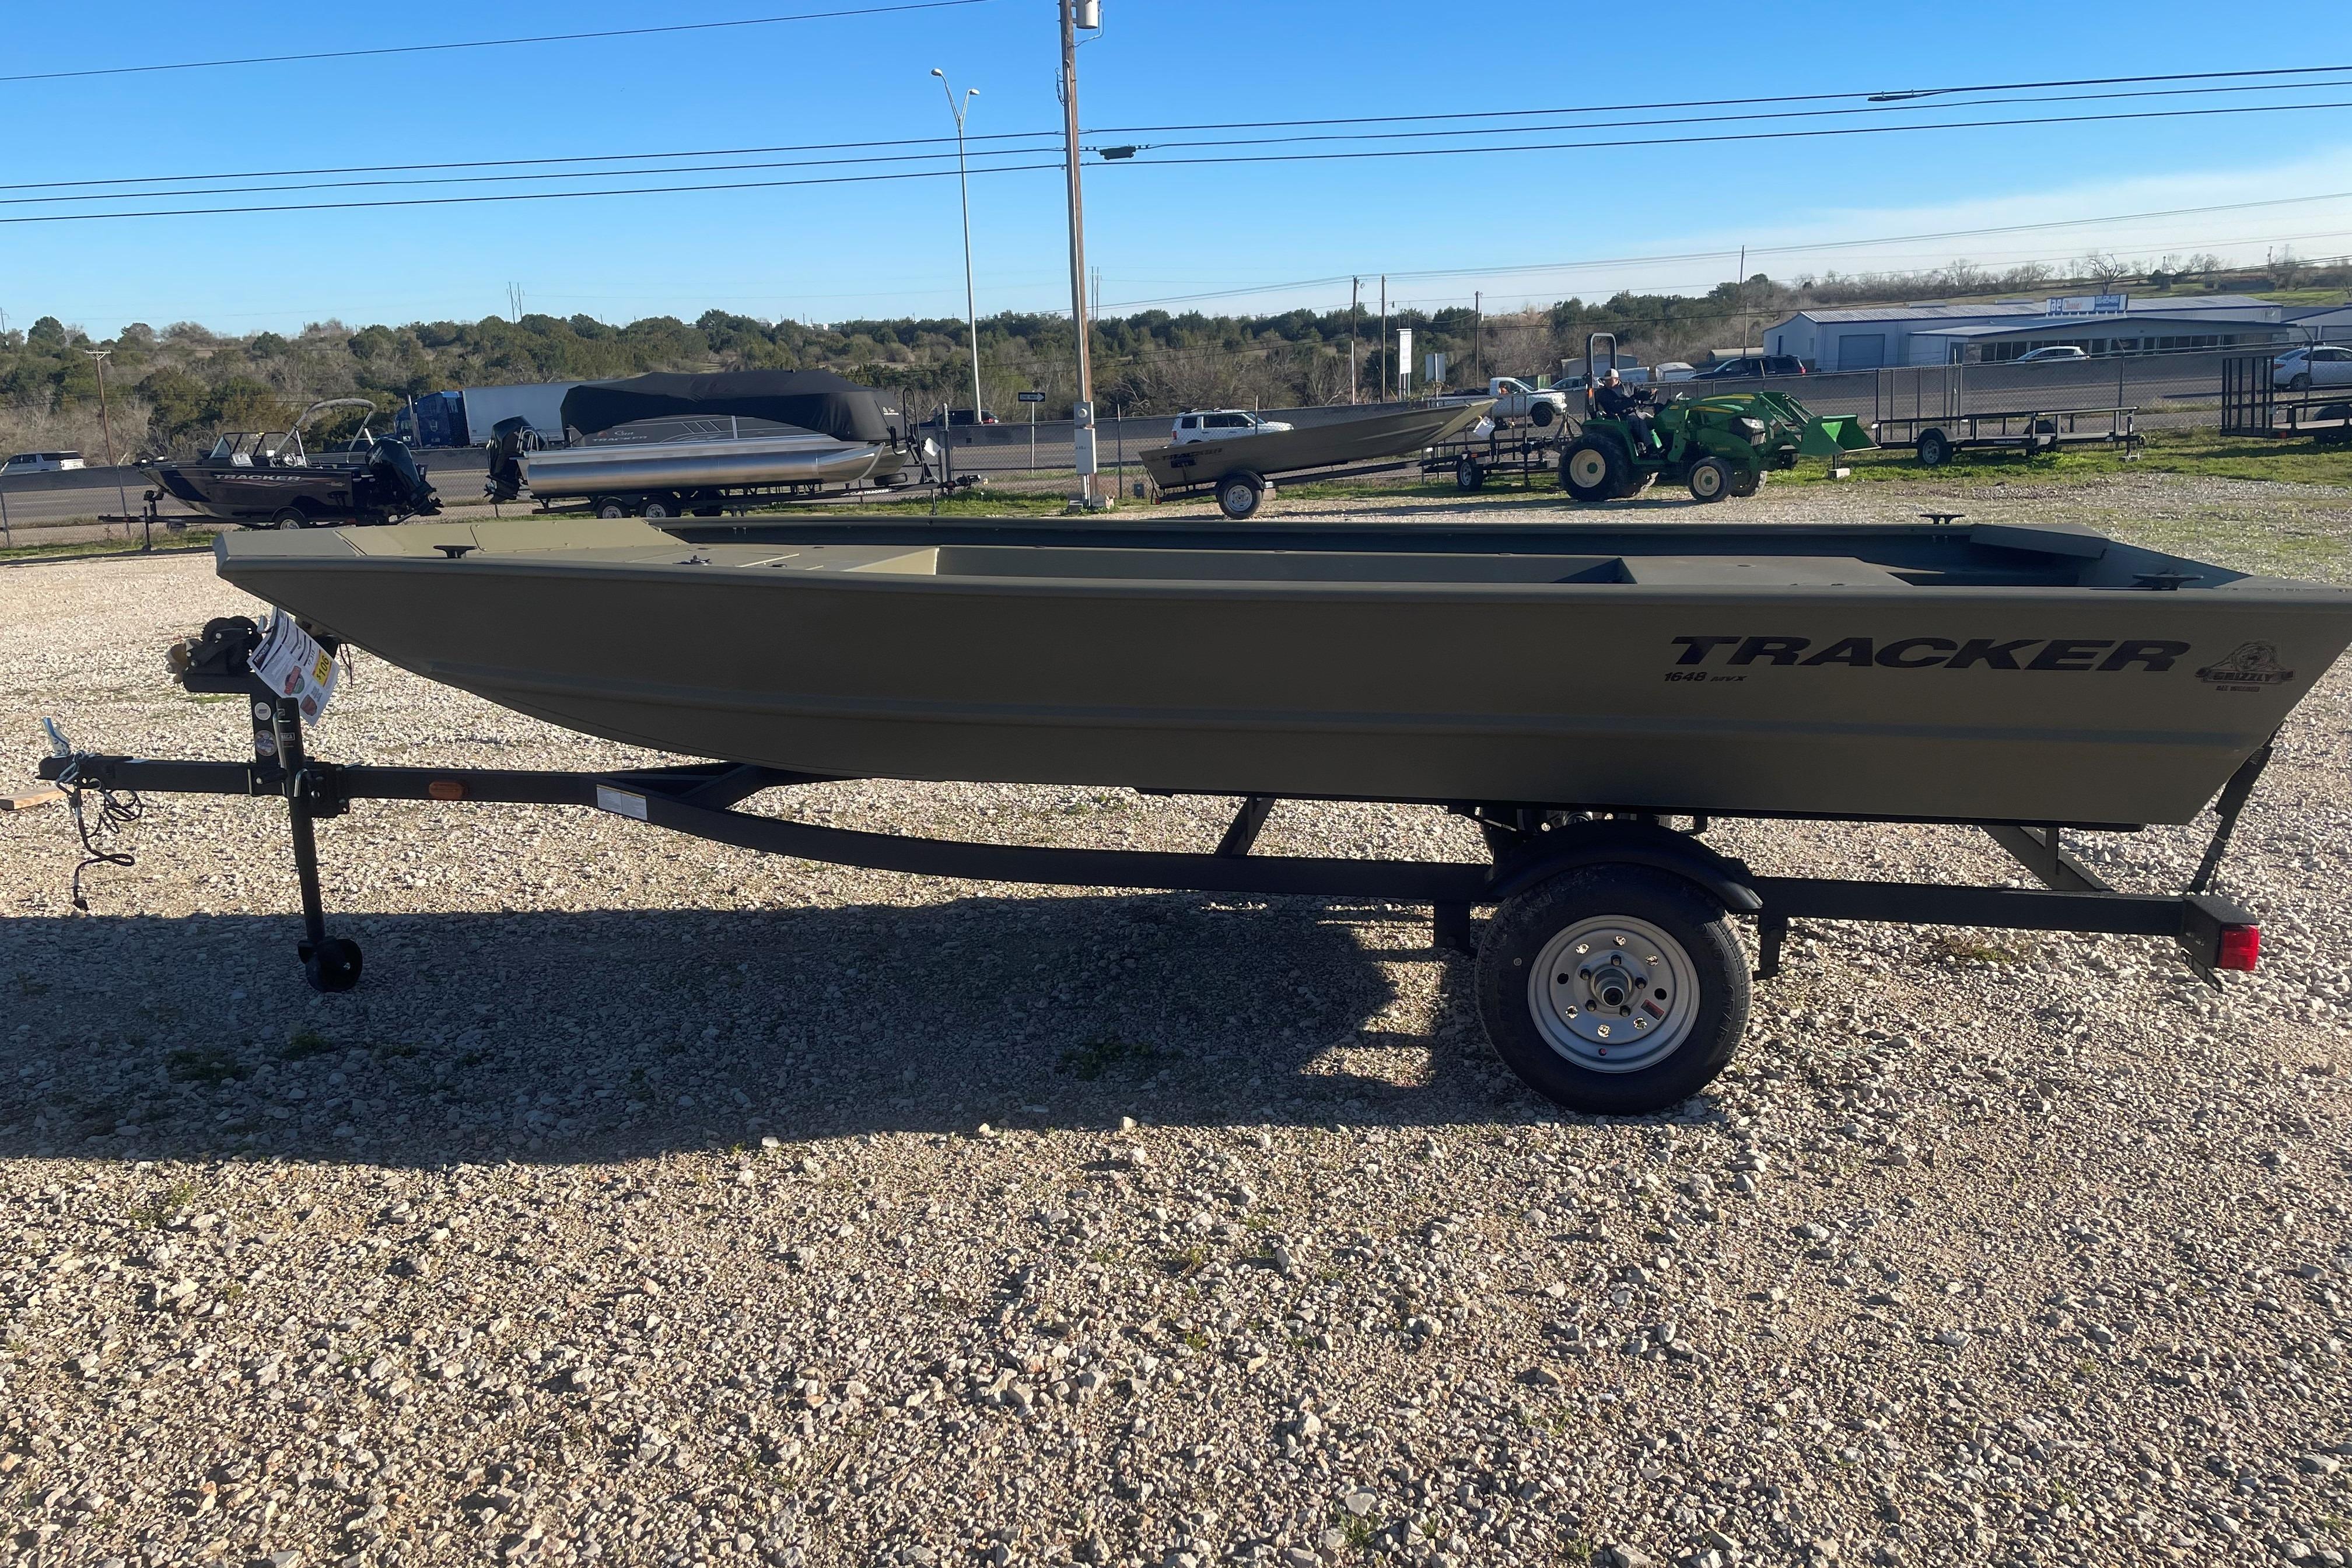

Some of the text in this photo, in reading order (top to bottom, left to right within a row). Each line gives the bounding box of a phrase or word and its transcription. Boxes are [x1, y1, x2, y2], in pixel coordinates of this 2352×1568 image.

[1671, 635, 2192, 671] TRACKER
[316, 654, 330, 681] $106
[1664, 671, 1707, 682] 1648
[2213, 671, 2276, 682] GRIZZLY
